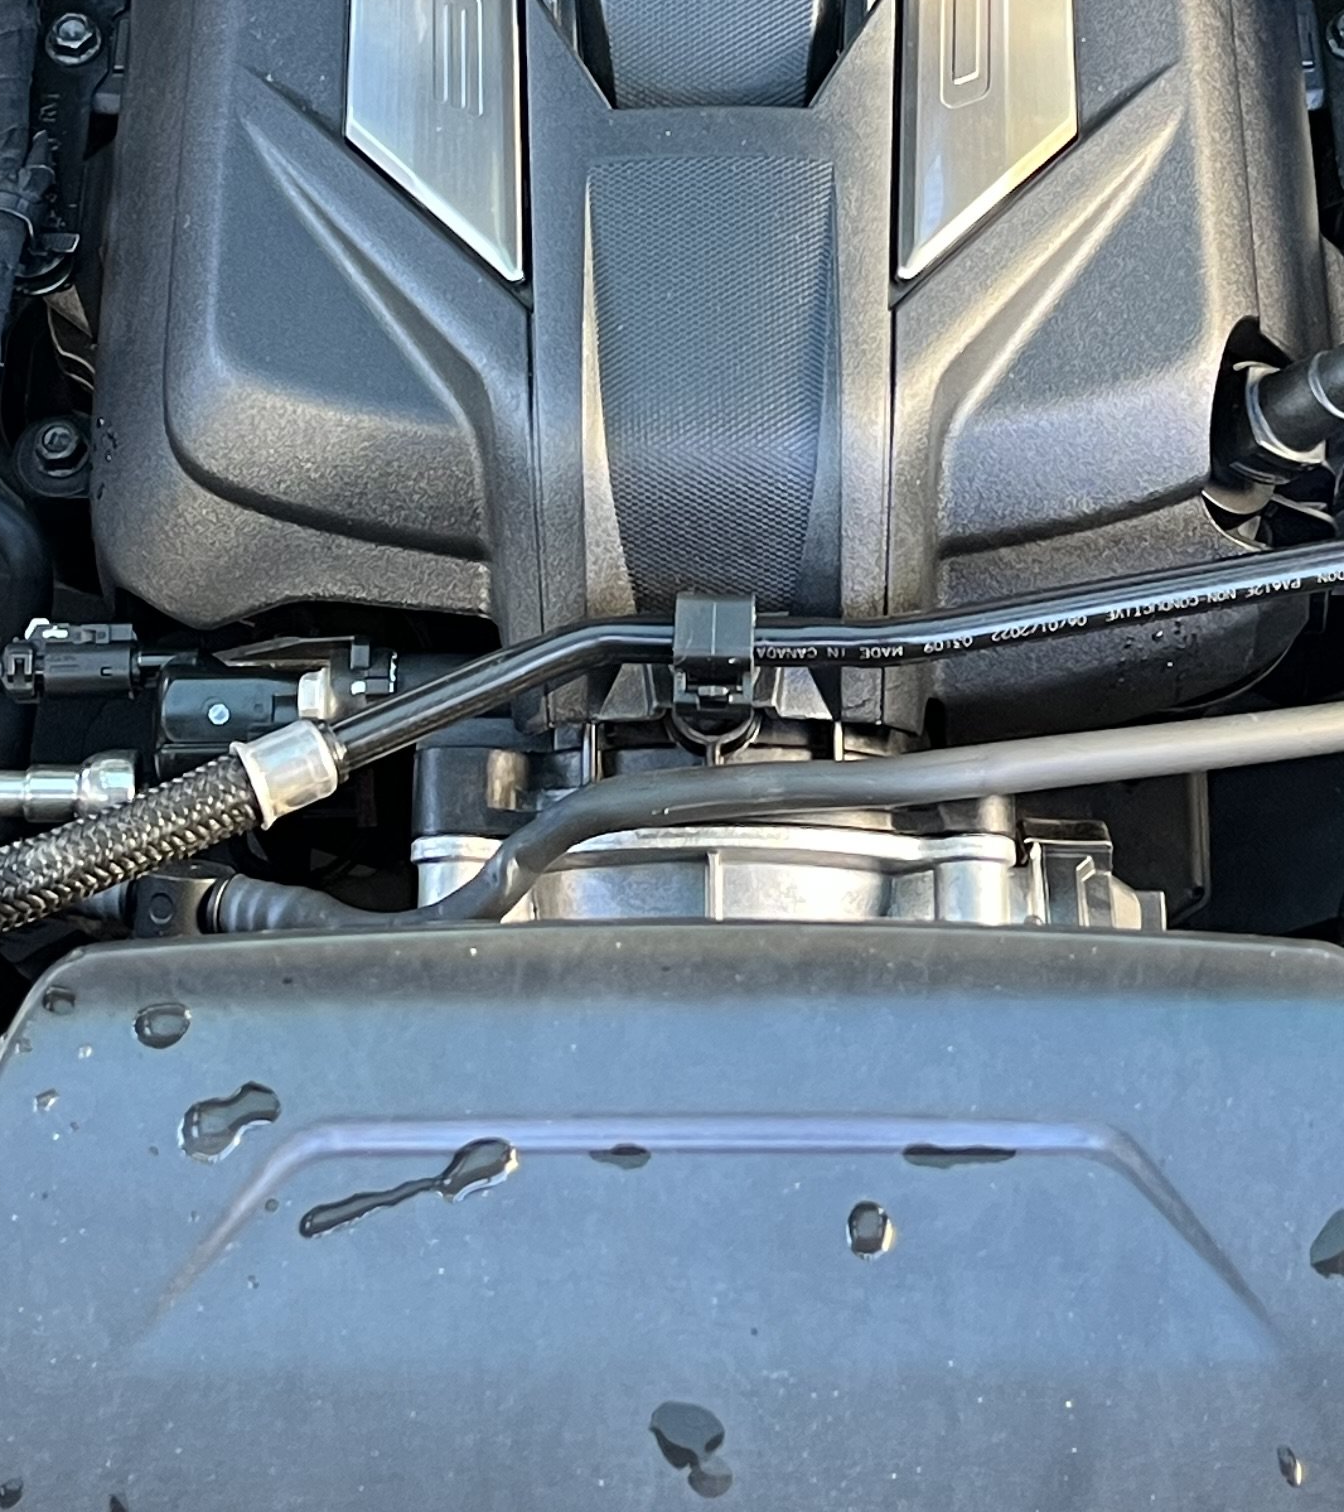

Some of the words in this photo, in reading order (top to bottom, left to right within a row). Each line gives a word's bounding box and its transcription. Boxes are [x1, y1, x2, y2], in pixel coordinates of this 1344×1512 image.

[756, 646, 818, 660] CANADA
[827, 647, 846, 659] IN
[859, 645, 904, 660] MADE
